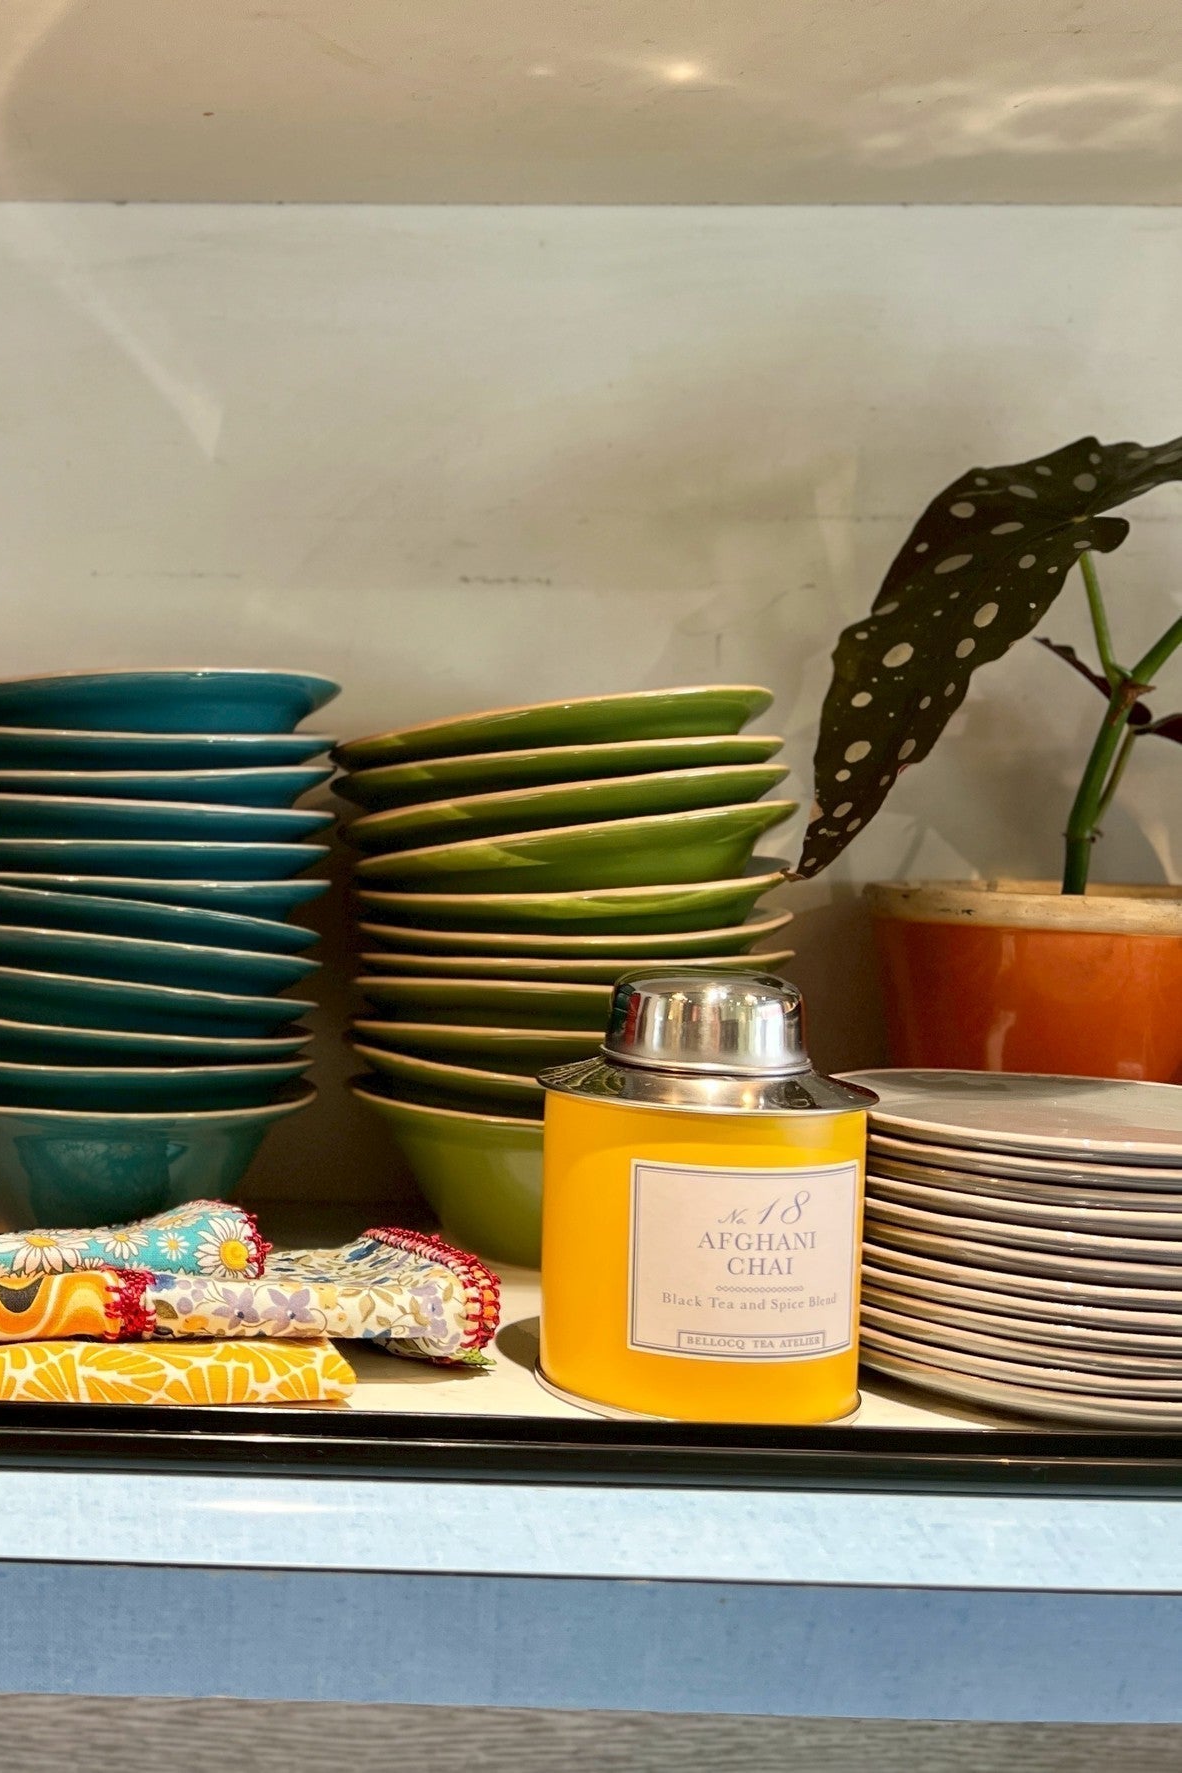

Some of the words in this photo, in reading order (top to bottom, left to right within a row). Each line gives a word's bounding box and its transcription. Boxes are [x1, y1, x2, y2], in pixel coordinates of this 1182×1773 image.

[757, 1190, 811, 1225] 18
[697, 1231, 817, 1251] AFGHANI
[726, 1257, 795, 1276] CHAI
[661, 1292, 702, 1308] Black
[708, 1297, 735, 1310] Tea
[739, 1299, 766, 1311] and
[770, 1299, 805, 1313] Spice
[807, 1294, 838, 1308] Blend
[686, 1337, 746, 1350] BELLOCQ
[753, 1339, 776, 1349] TEA
[779, 1337, 821, 1349] ATELIER
